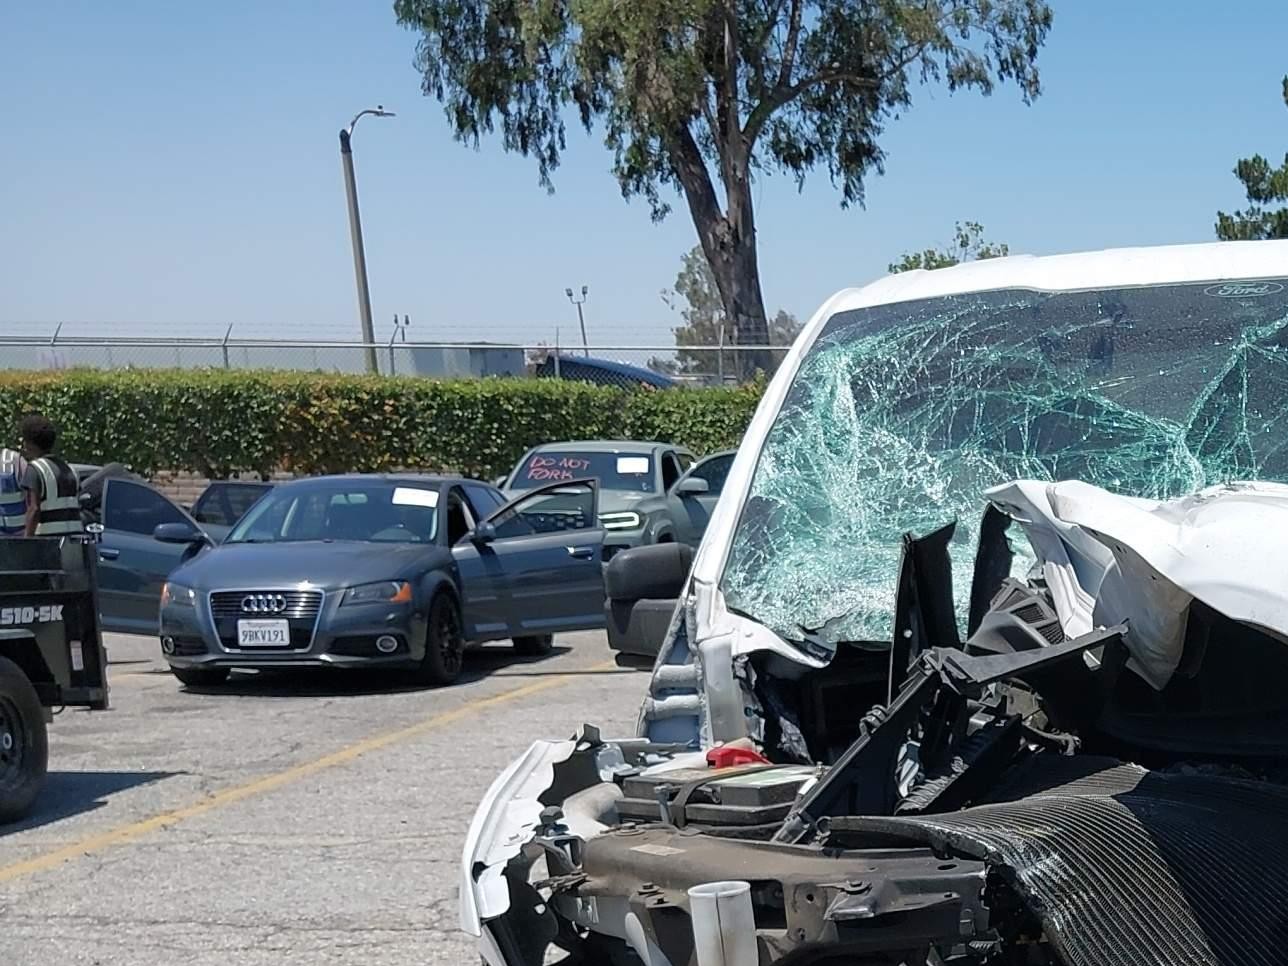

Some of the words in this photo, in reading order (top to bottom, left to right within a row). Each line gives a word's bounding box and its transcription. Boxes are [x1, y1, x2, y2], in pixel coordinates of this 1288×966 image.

[1218, 282, 1270, 296] Ford
[530, 456, 556, 468] DO
[559, 458, 591, 471] NOT
[527, 468, 573, 480] FORK
